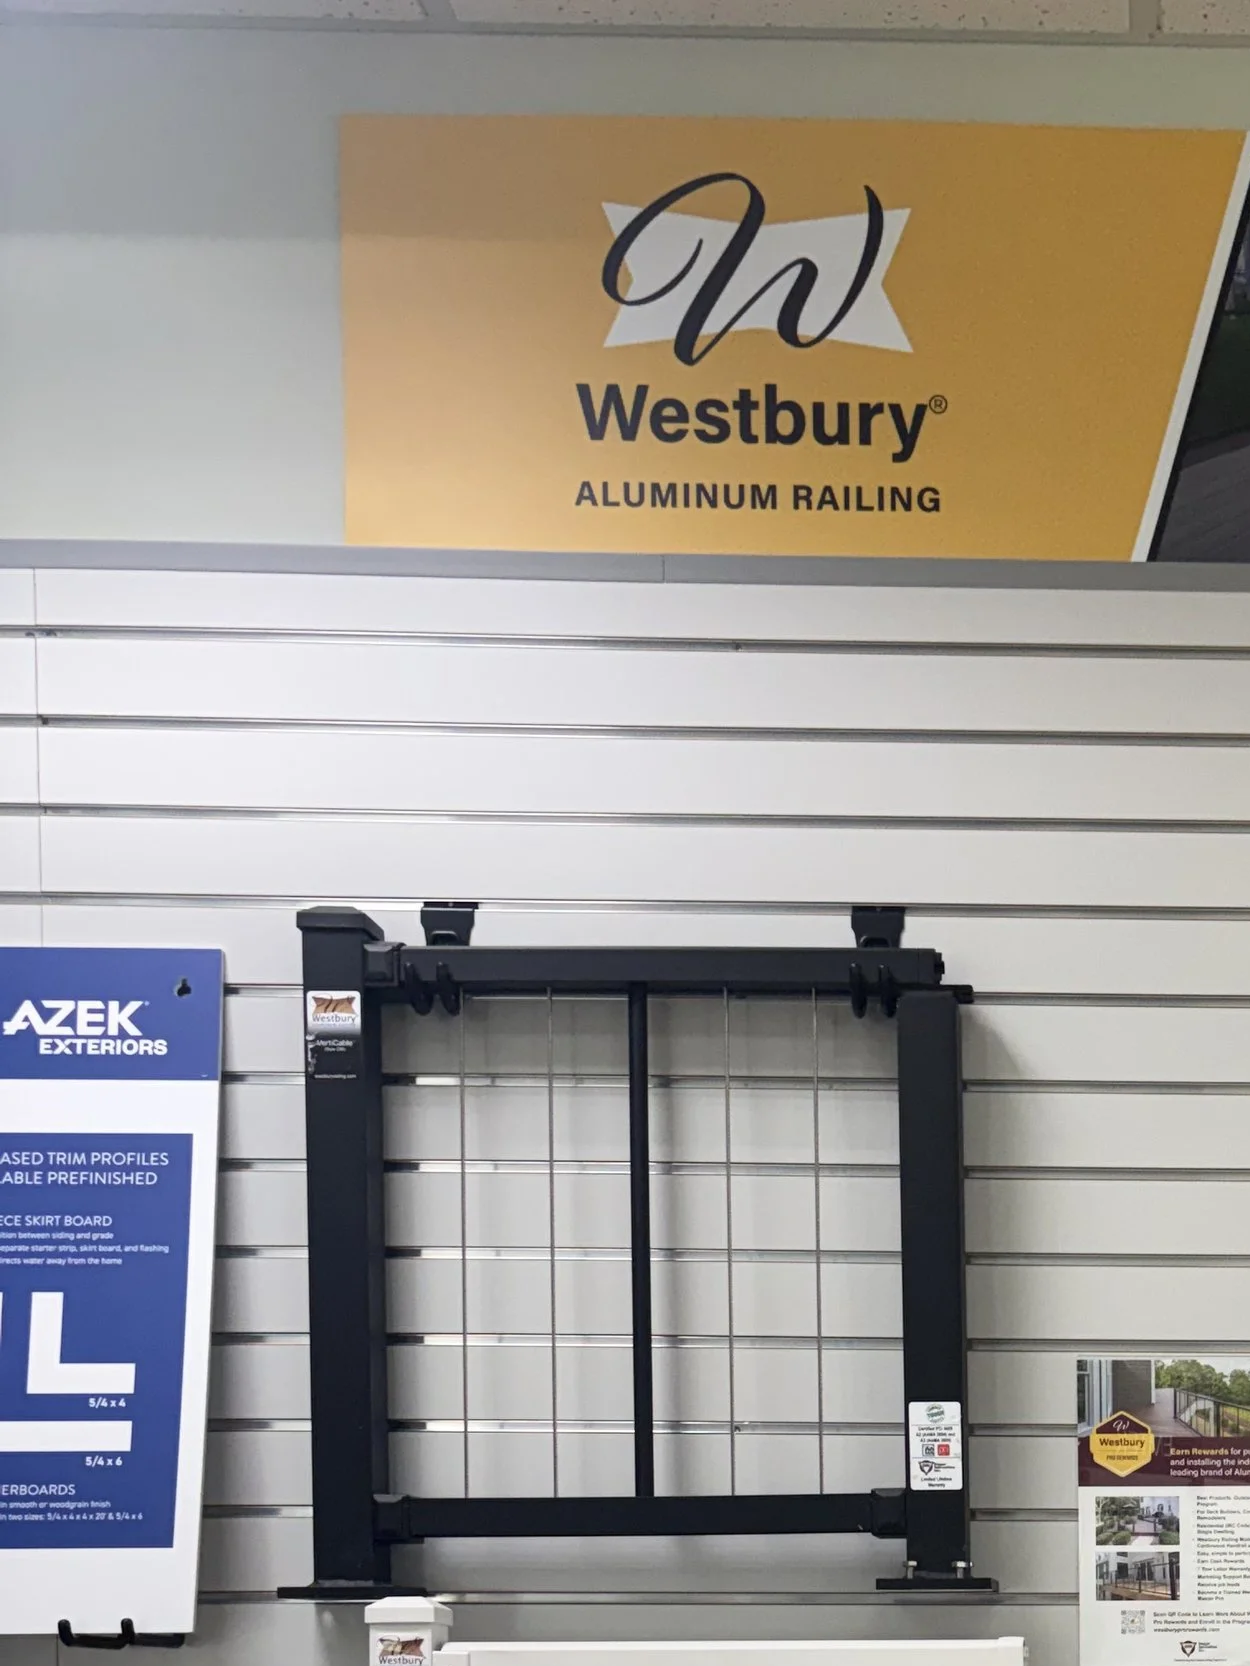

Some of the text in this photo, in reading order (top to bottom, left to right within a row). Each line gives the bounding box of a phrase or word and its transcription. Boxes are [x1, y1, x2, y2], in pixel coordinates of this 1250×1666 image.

[575, 481, 942, 513] ALUMINUM RAILING
[3, 999, 144, 1036] AZEK
[39, 1038, 168, 1056] EXTERIORS
[0, 1151, 169, 1166] ASED TRIM PROFILES
[47, 1171, 158, 1186] PREFINISHED
[25, 1215, 61, 1227] SKIRT
[64, 1215, 113, 1227] BOARD
[18, 1231, 114, 1241] between siding and grade
[80, 1244, 97, 1252] skirt
[139, 1244, 170, 1254] flashing
[46, 1258, 67, 1266] away
[67, 1257, 86, 1265] from
[87, 1257, 100, 1265] the
[101, 1257, 123, 1265] home
[88, 1397, 108, 1409] 5/4
[118, 1398, 126, 1408] 4
[1099, 1437, 1145, 1448] Westbury
[85, 1455, 123, 1467] 5/4 x 6
[1170, 1458, 1185, 1466] and
[1186, 1458, 1221, 1467] installing
[1223, 1458, 1235, 1466] the
[1170, 1468, 1199, 1477] leading
[1200, 1468, 1223, 1476] brand
[1224, 1468, 1233, 1476] of
[9, 1500, 38, 1509] smooth
[49, 1500, 89, 1510] woodgrain
[90, 1500, 111, 1509] finish
[8, 1512, 23, 1521] two
[47, 1512, 61, 1521] 5/4
[115, 1512, 130, 1521] 5/4
